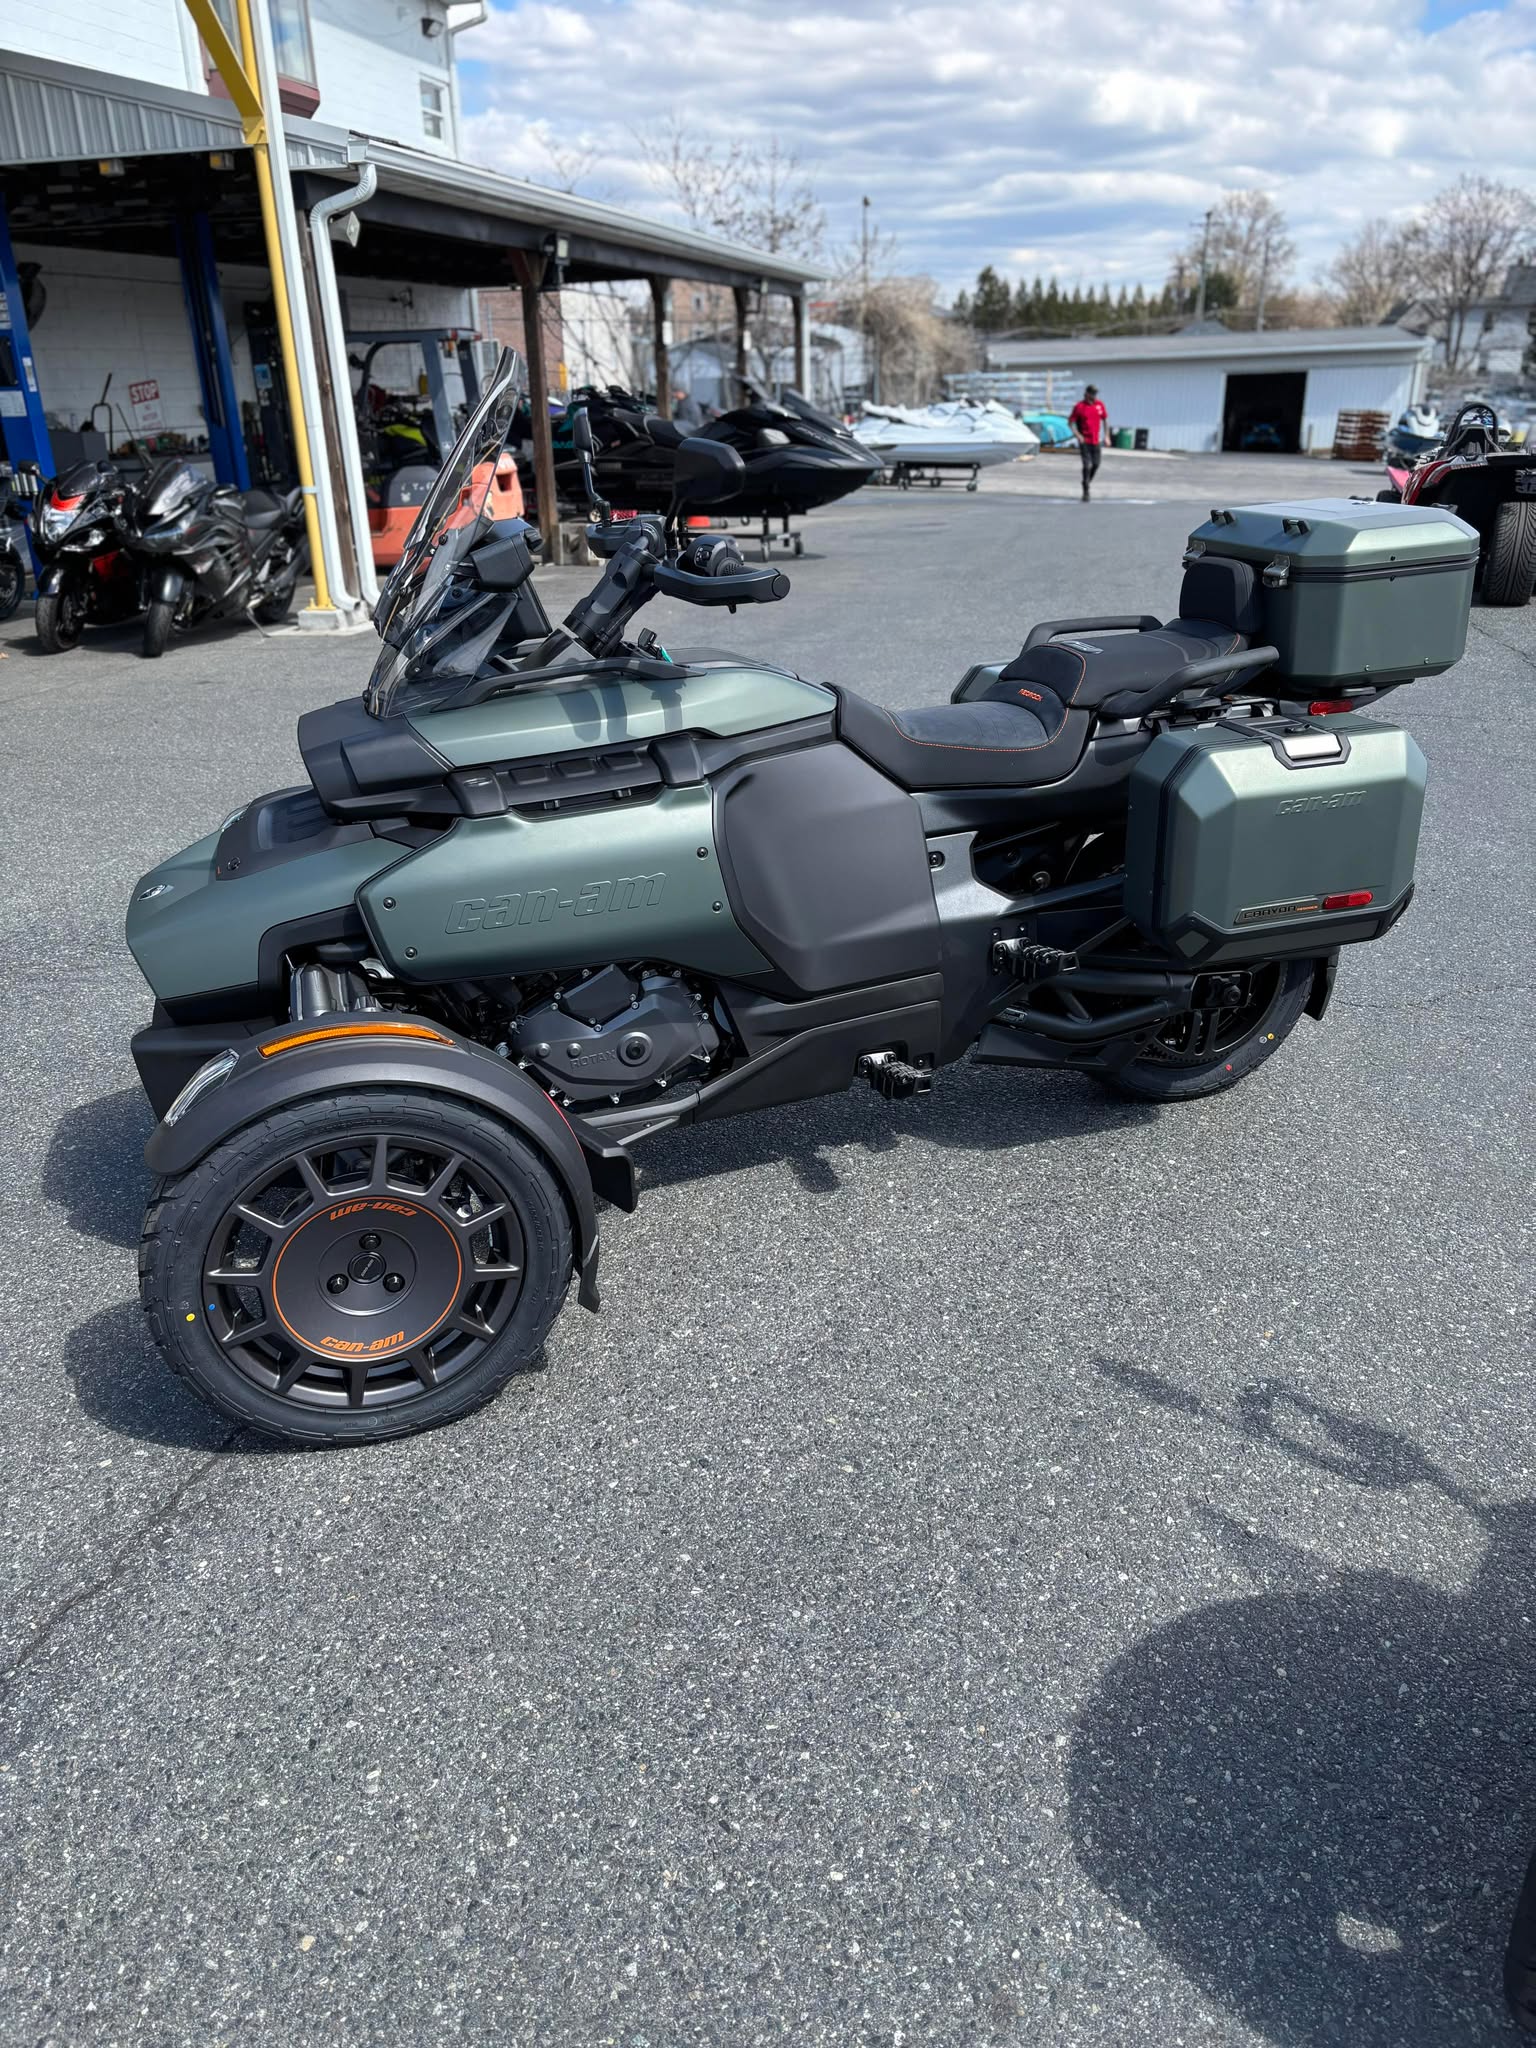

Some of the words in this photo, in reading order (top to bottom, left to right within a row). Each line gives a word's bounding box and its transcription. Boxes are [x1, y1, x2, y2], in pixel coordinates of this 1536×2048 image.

[131, 383, 158, 402] STOP
[1275, 791, 1367, 816] can-am
[445, 872, 667, 934] can-am
[1244, 905, 1297, 919] CANYON
[570, 1050, 616, 1069] ROTAX
[329, 1202, 418, 1221] can-am
[320, 1331, 405, 1352] can-am
